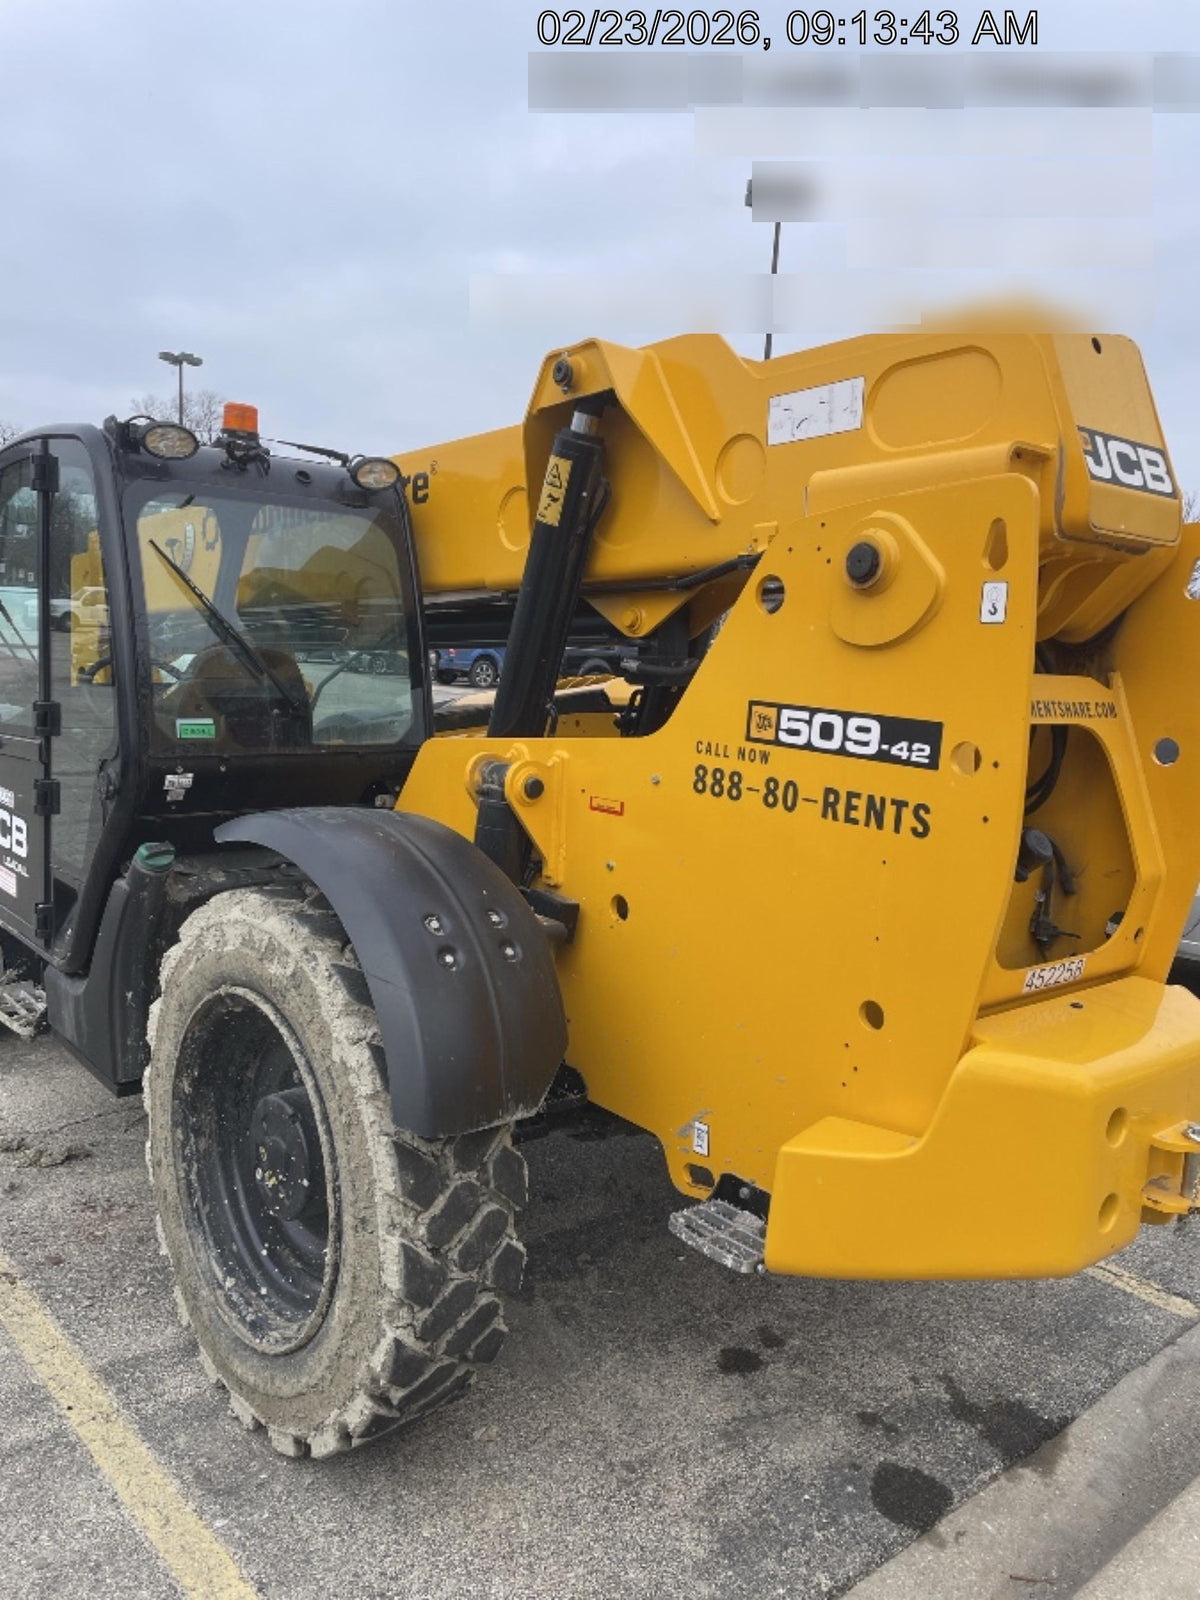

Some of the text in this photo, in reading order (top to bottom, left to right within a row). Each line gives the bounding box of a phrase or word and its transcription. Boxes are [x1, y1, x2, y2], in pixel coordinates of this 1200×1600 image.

[1084, 434, 1174, 493] JCB
[696, 740, 771, 765] CALL NOW
[778, 708, 932, 764] 509-42
[692, 764, 932, 839] 888-80-RENTS
[1025, 959, 1084, 990] 452258
